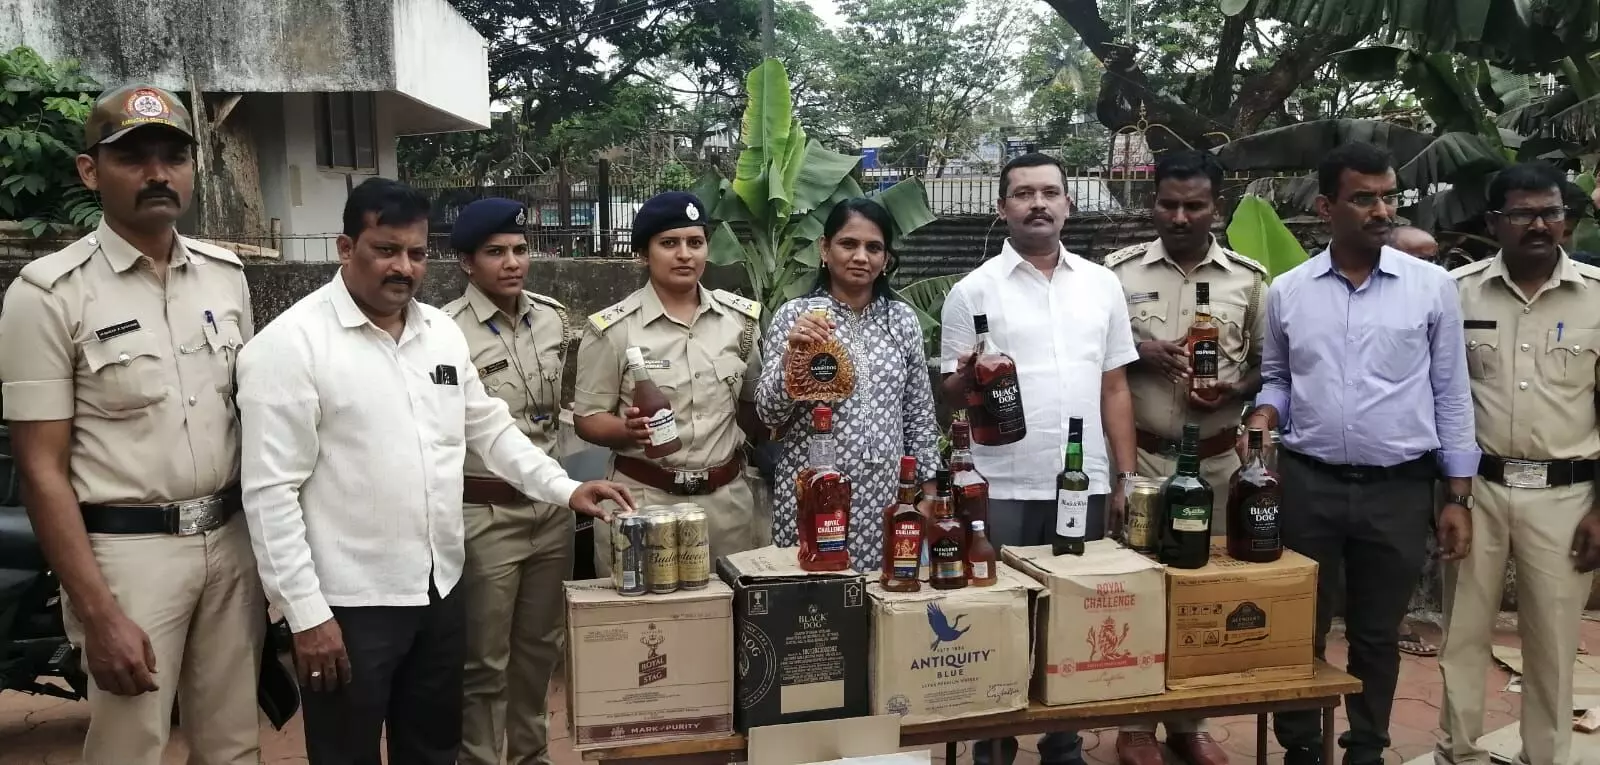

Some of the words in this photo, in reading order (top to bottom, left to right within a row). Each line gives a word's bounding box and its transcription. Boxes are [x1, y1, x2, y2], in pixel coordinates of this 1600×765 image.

[992, 385, 1019, 399] BLACK
[998, 395, 1016, 404] DOG
[1250, 505, 1279, 515] BLACK
[824, 519, 840, 527] ROYAL
[1255, 514, 1275, 522] DOG
[817, 526, 845, 534] CHALLENGE
[1096, 582, 1125, 595] ROYAL
[1083, 594, 1136, 610] CHALLENGE
[798, 613, 827, 623] BLACK
[803, 622, 822, 630] DOG
[641, 658, 664, 671] ROYAL
[910, 649, 991, 670] ANTIQUITY
[643, 672, 663, 684] STAG
[937, 668, 964, 679] BLUE
[631, 725, 659, 735] MARK
[665, 722, 700, 731] PURITY
